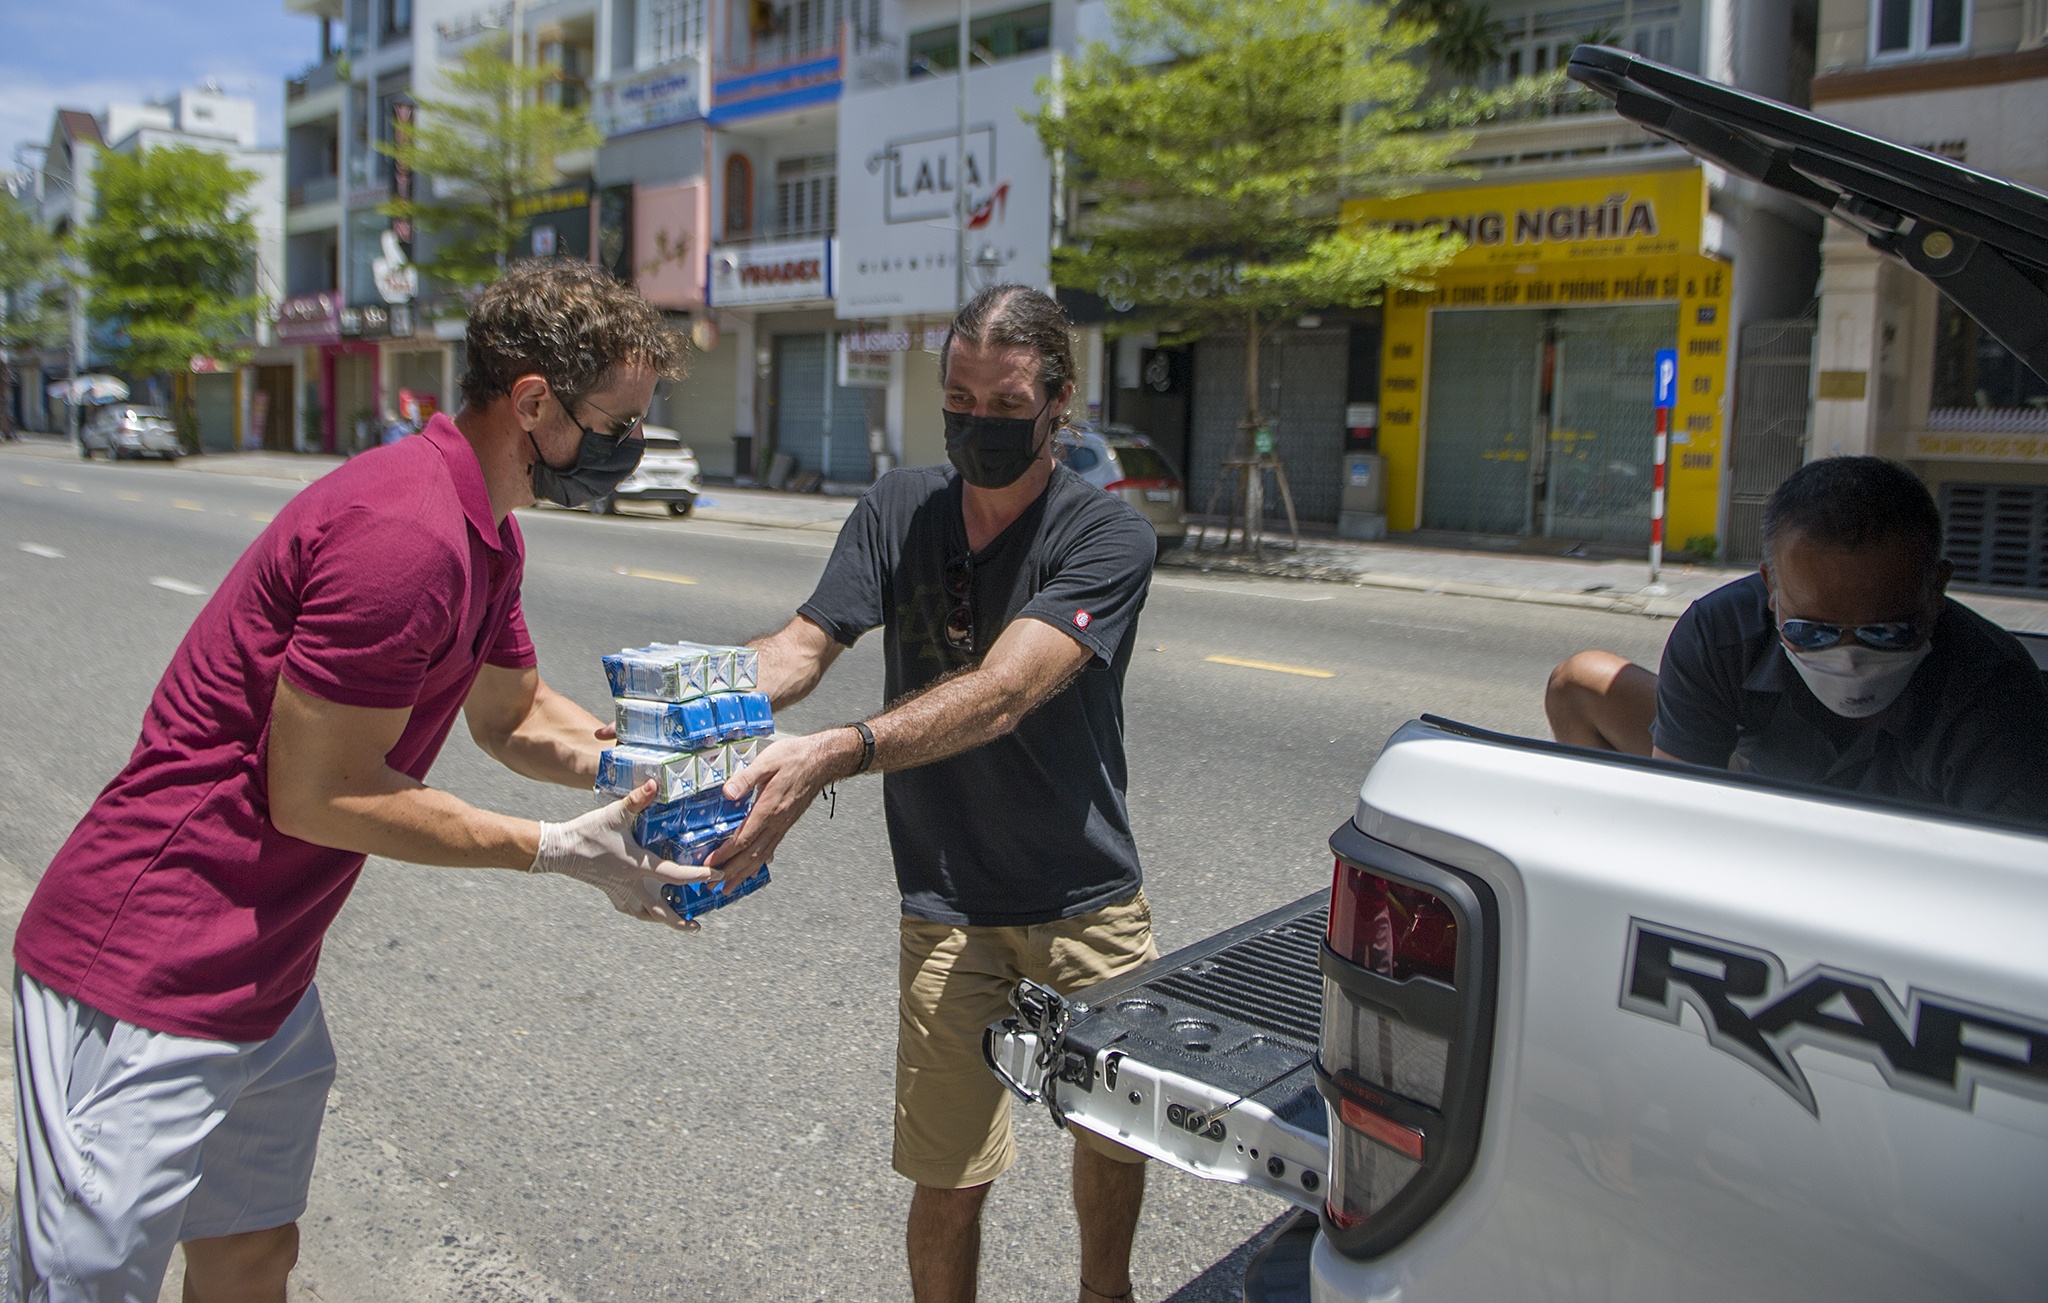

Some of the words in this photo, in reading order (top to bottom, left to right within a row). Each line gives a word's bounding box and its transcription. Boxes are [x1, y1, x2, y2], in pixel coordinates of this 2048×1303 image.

[893, 151, 981, 198] LALA
[1516, 193, 1659, 247] NGHĨA
[1339, 1077, 1384, 1107] RANGER
